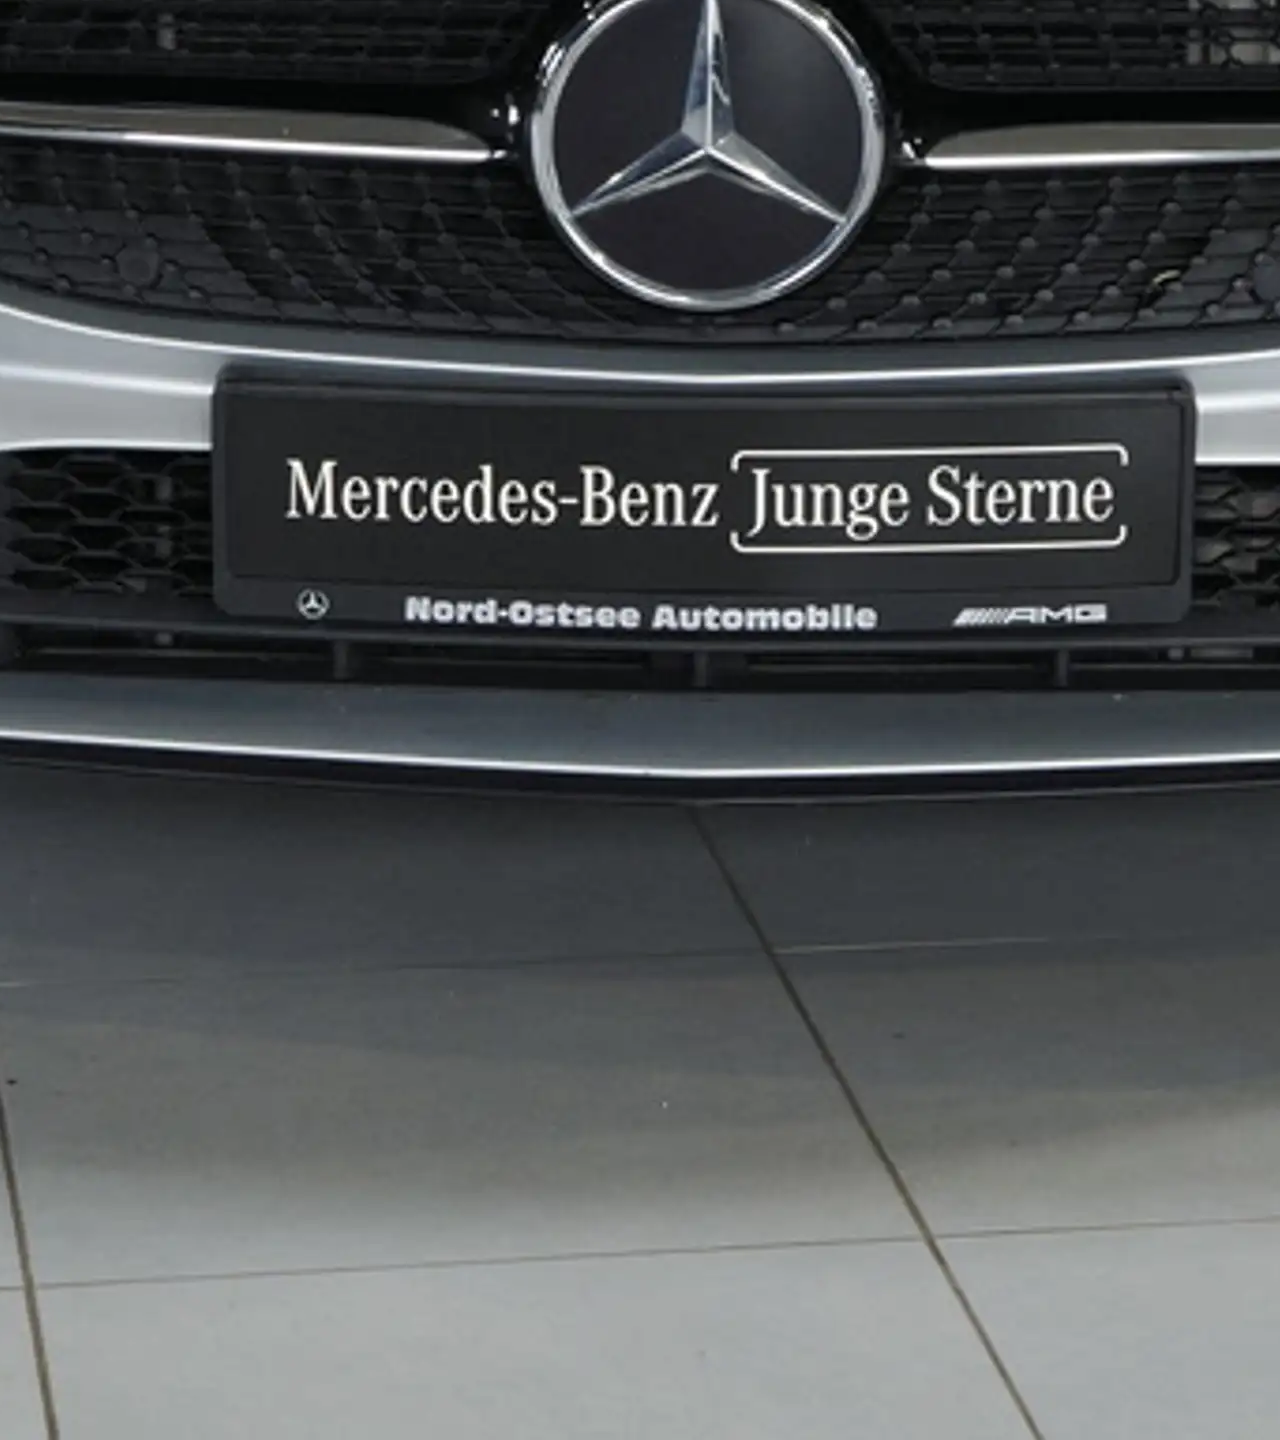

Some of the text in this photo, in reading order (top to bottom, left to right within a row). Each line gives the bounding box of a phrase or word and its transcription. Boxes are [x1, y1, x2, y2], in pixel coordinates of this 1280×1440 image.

[286, 458, 1114, 541] Mercedes-Benz Junge Sterne
[404, 595, 878, 631] Nord-Ostsee Automobile
[1002, 603, 1108, 625] AMG
